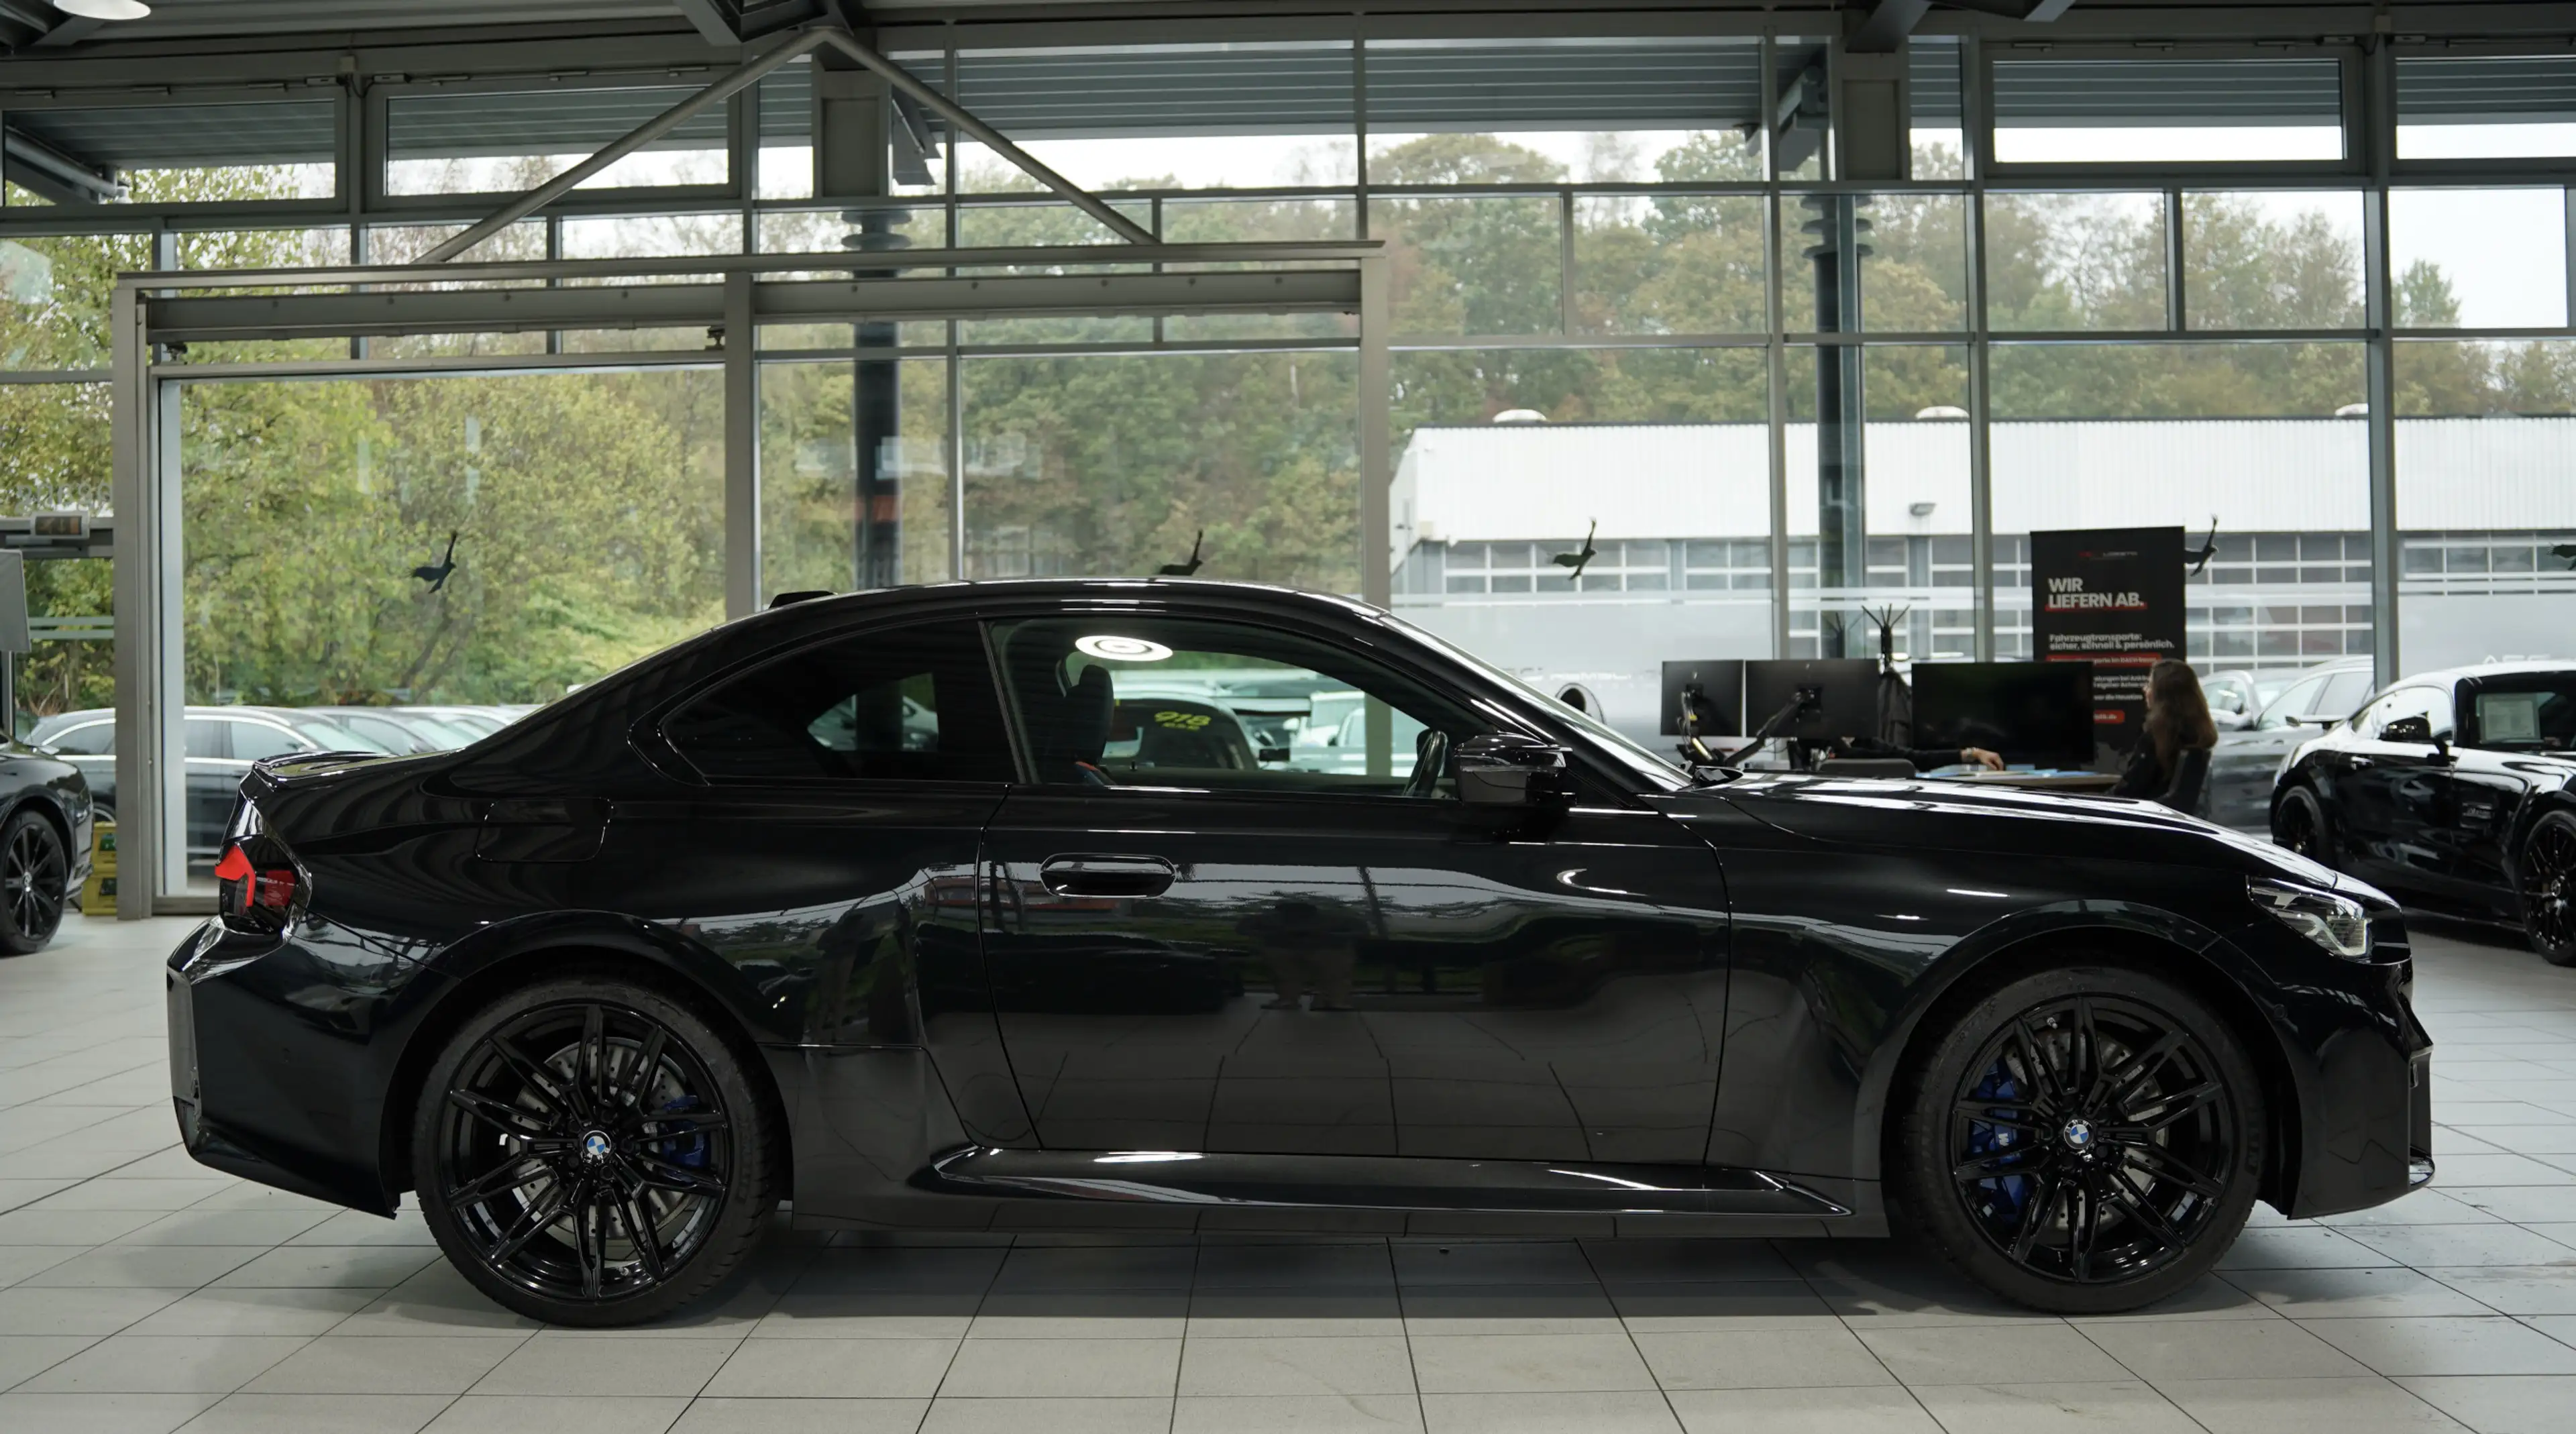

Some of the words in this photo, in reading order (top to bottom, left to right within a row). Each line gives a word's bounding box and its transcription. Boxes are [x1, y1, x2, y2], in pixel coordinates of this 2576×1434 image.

[2048, 577, 2083, 592] WIR
[2049, 593, 2112, 608] LIEFERN
[2115, 592, 2144, 607] AB.
[2049, 633, 2142, 643] Fahrzeugtransporte:
[2082, 641, 2112, 650] schnell
[2115, 641, 2123, 649] &
[2124, 639, 2175, 651] persönlich.
